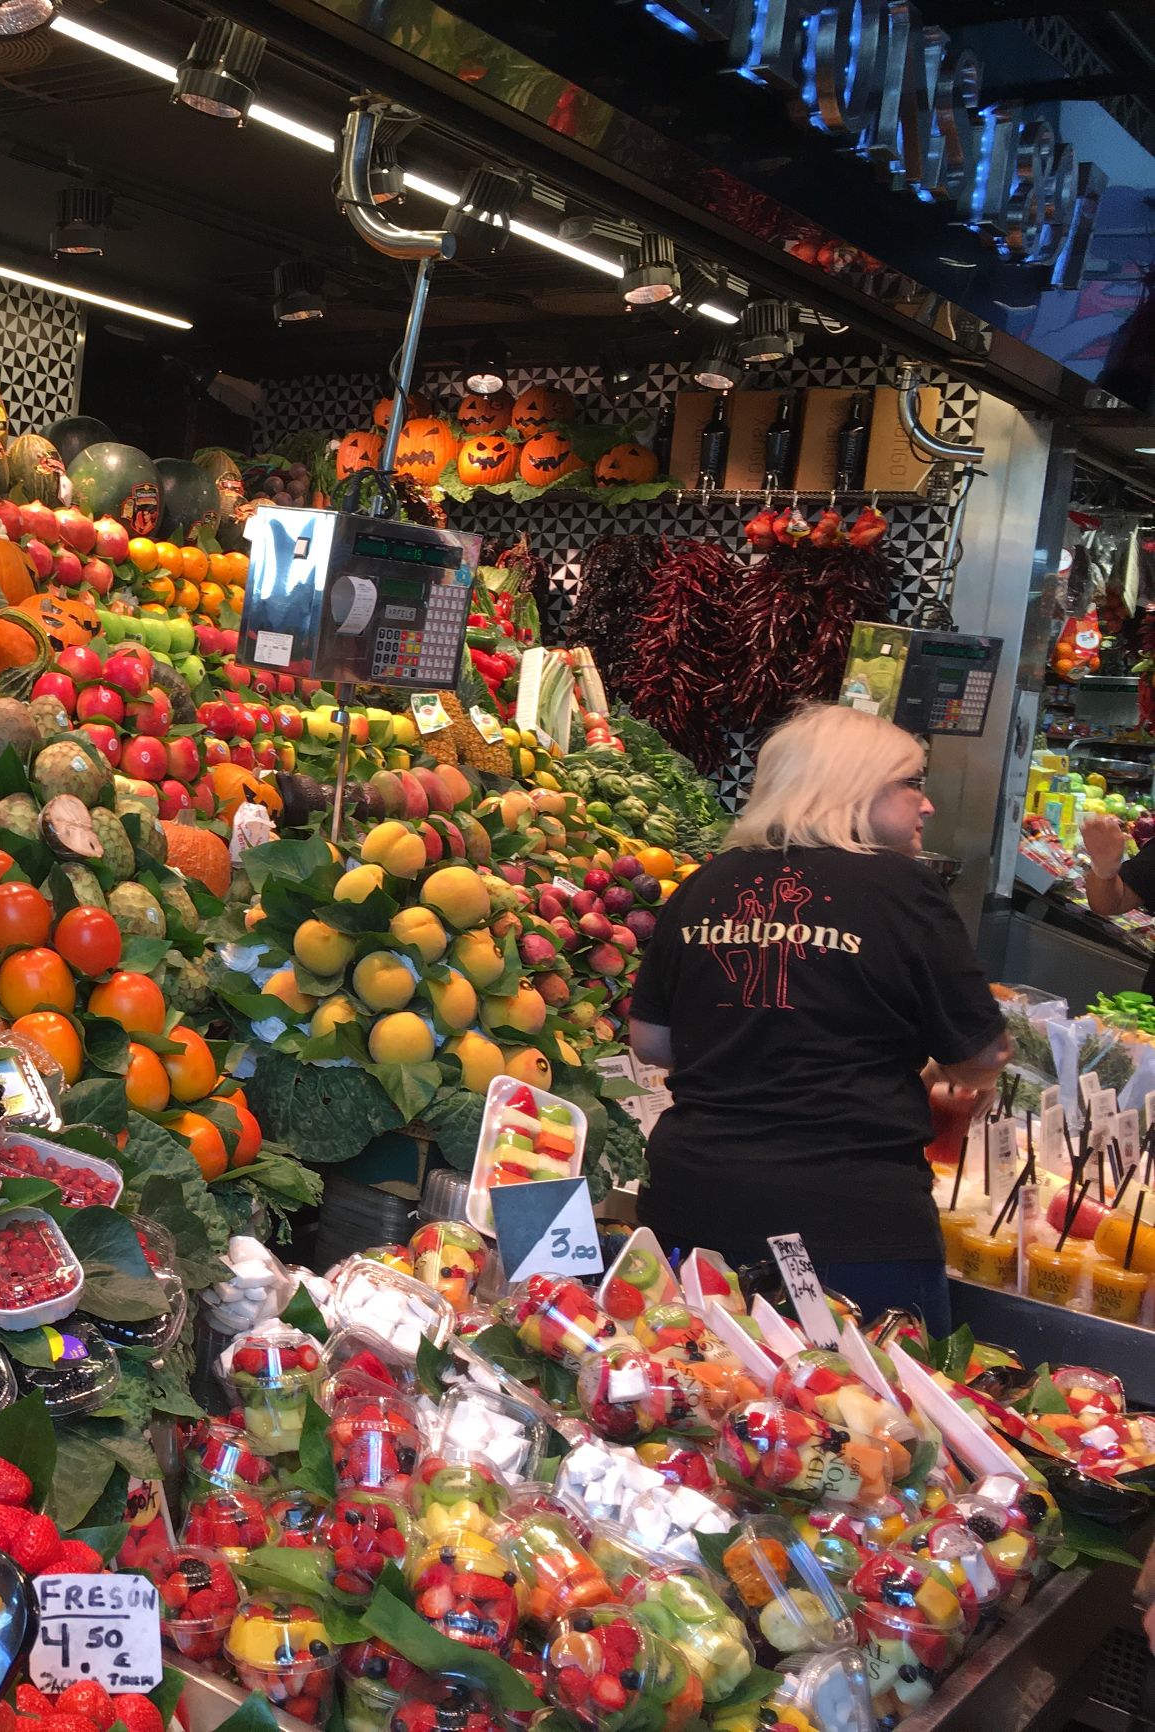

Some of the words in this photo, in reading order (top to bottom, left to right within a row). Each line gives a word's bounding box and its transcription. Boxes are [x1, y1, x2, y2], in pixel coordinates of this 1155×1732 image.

[680, 917, 863, 955] vidalpons
[1037, 1280, 1070, 1295] PONS
[849, 1457, 861, 1482] 1897
[40, 1576, 156, 1612] FRESÓN
